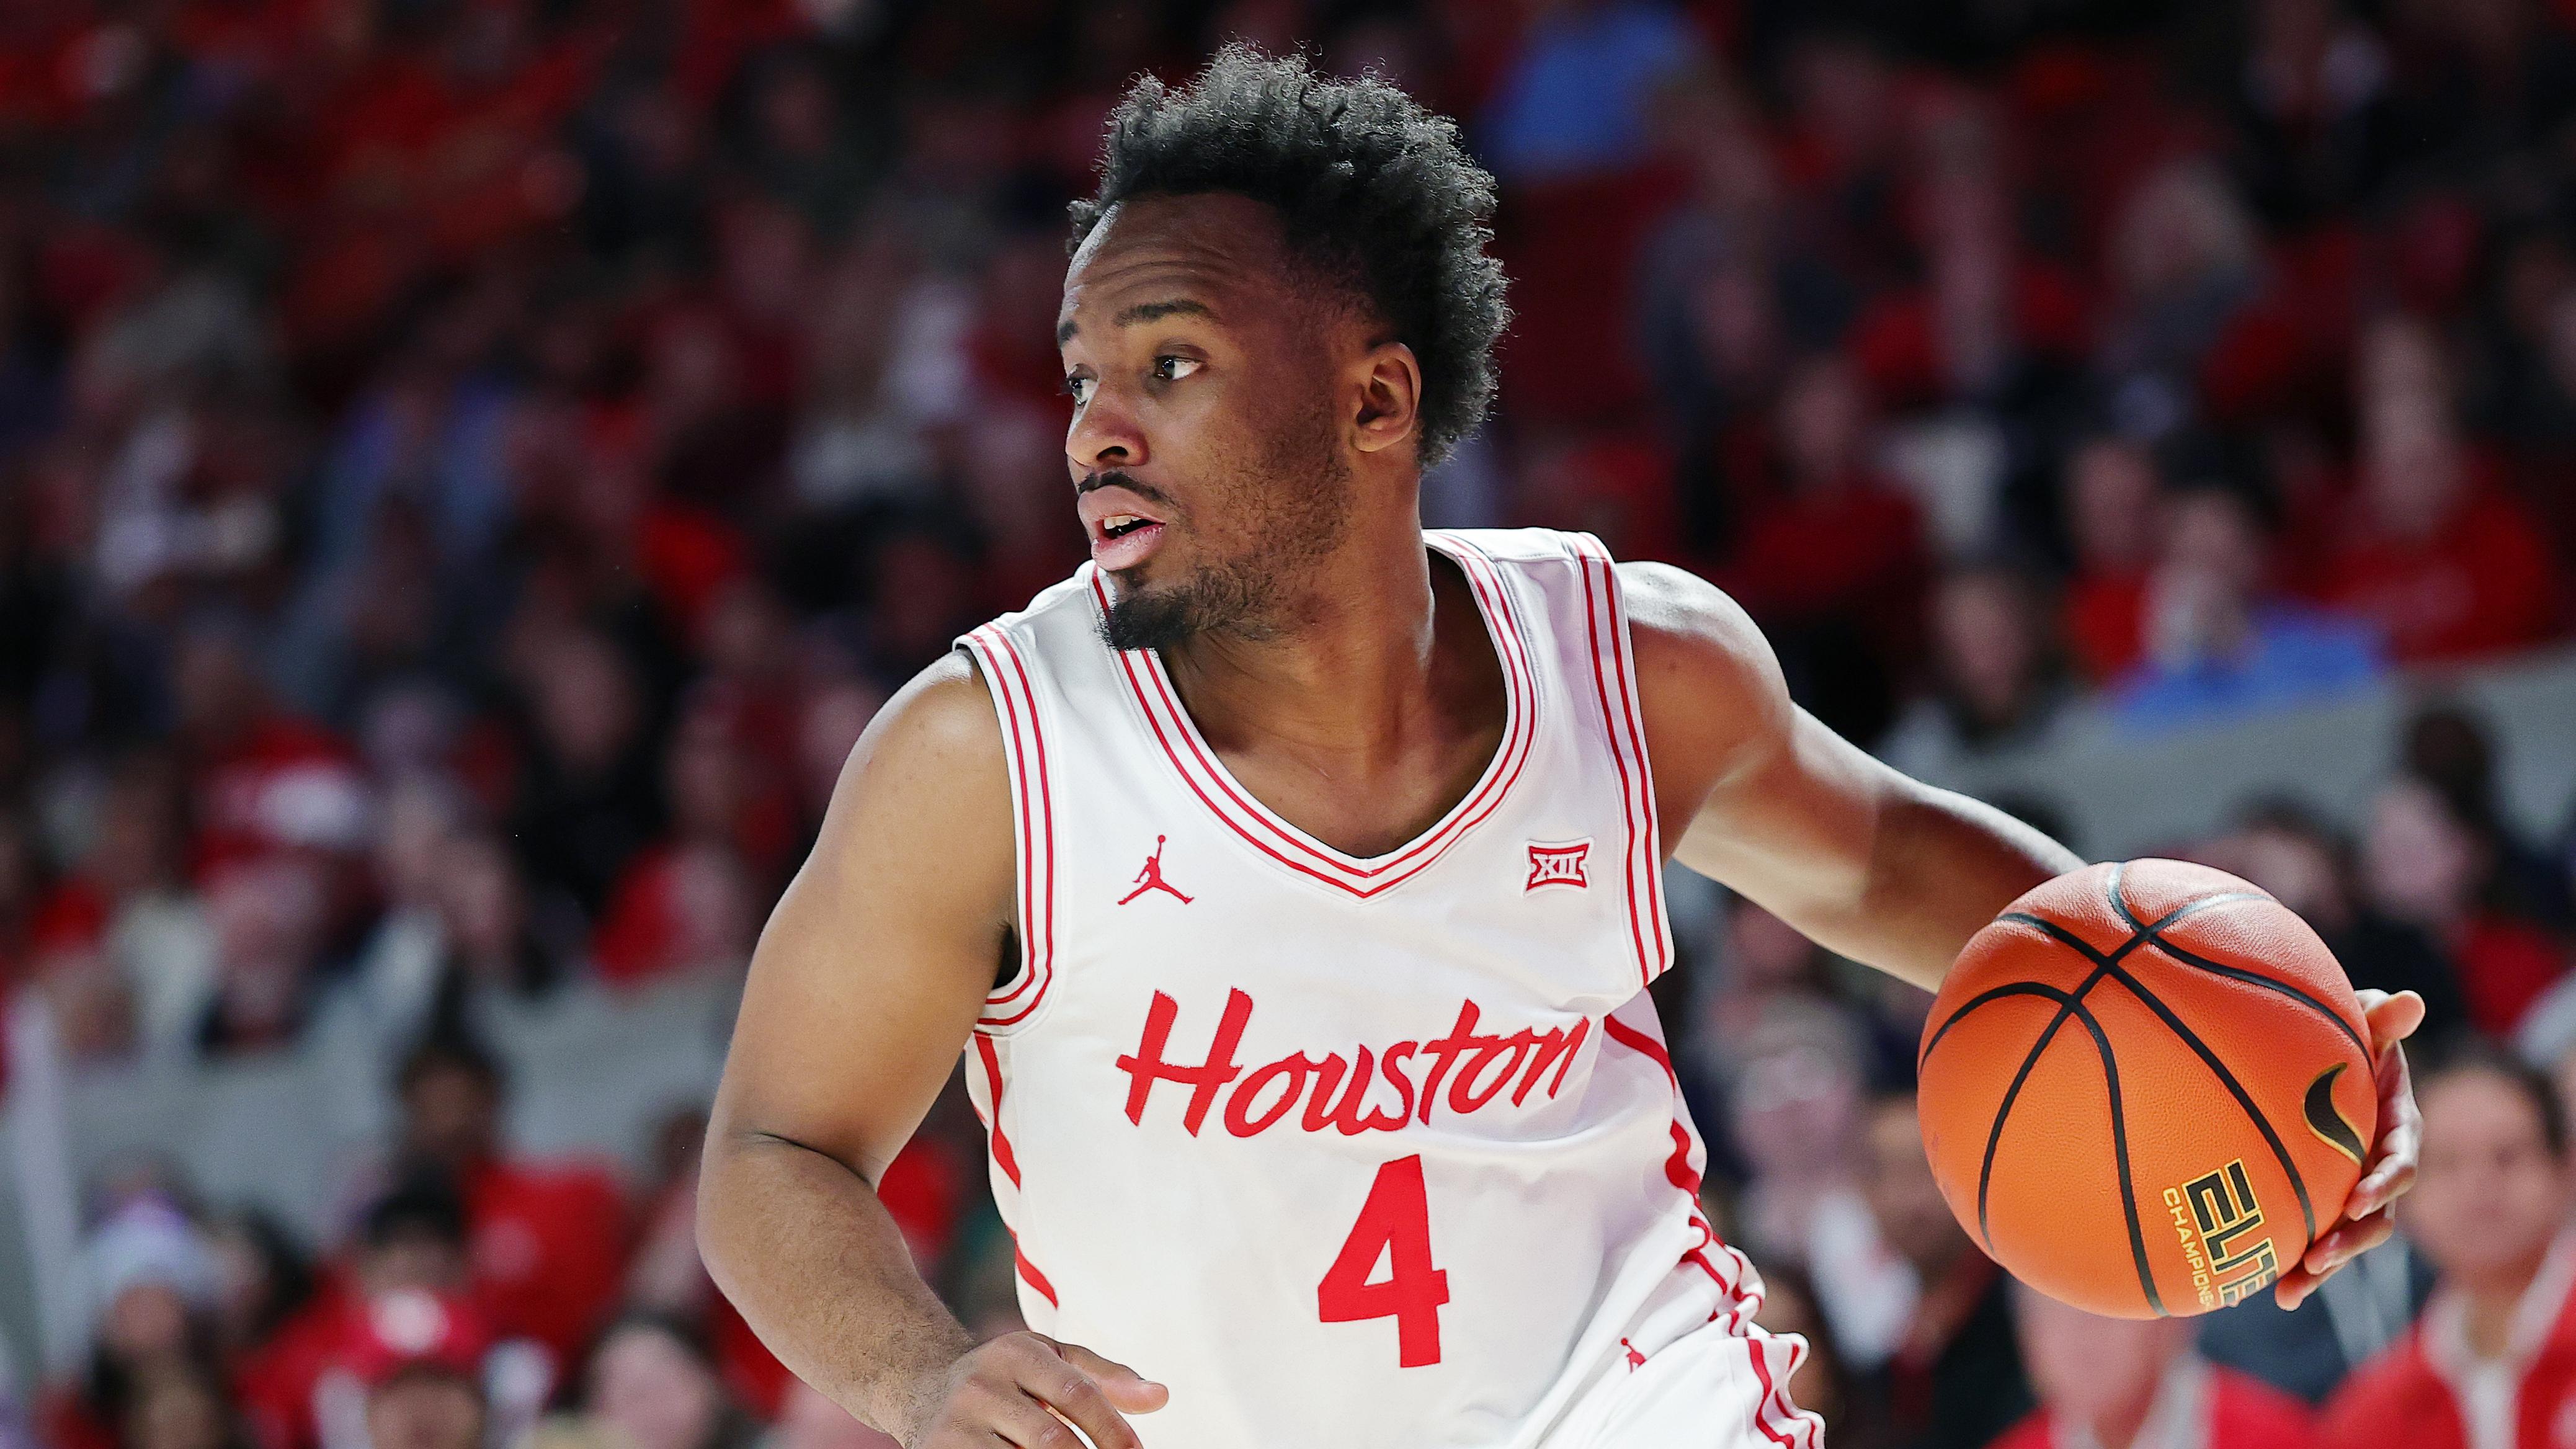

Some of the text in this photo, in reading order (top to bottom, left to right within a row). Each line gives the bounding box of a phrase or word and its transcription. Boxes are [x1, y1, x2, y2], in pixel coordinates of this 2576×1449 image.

[1531, 850, 1585, 885] XII
[1116, 986, 1590, 1138] Houston
[1317, 1154, 1450, 1368] 4
[2162, 1187, 2214, 1308] CHAMPIONS
